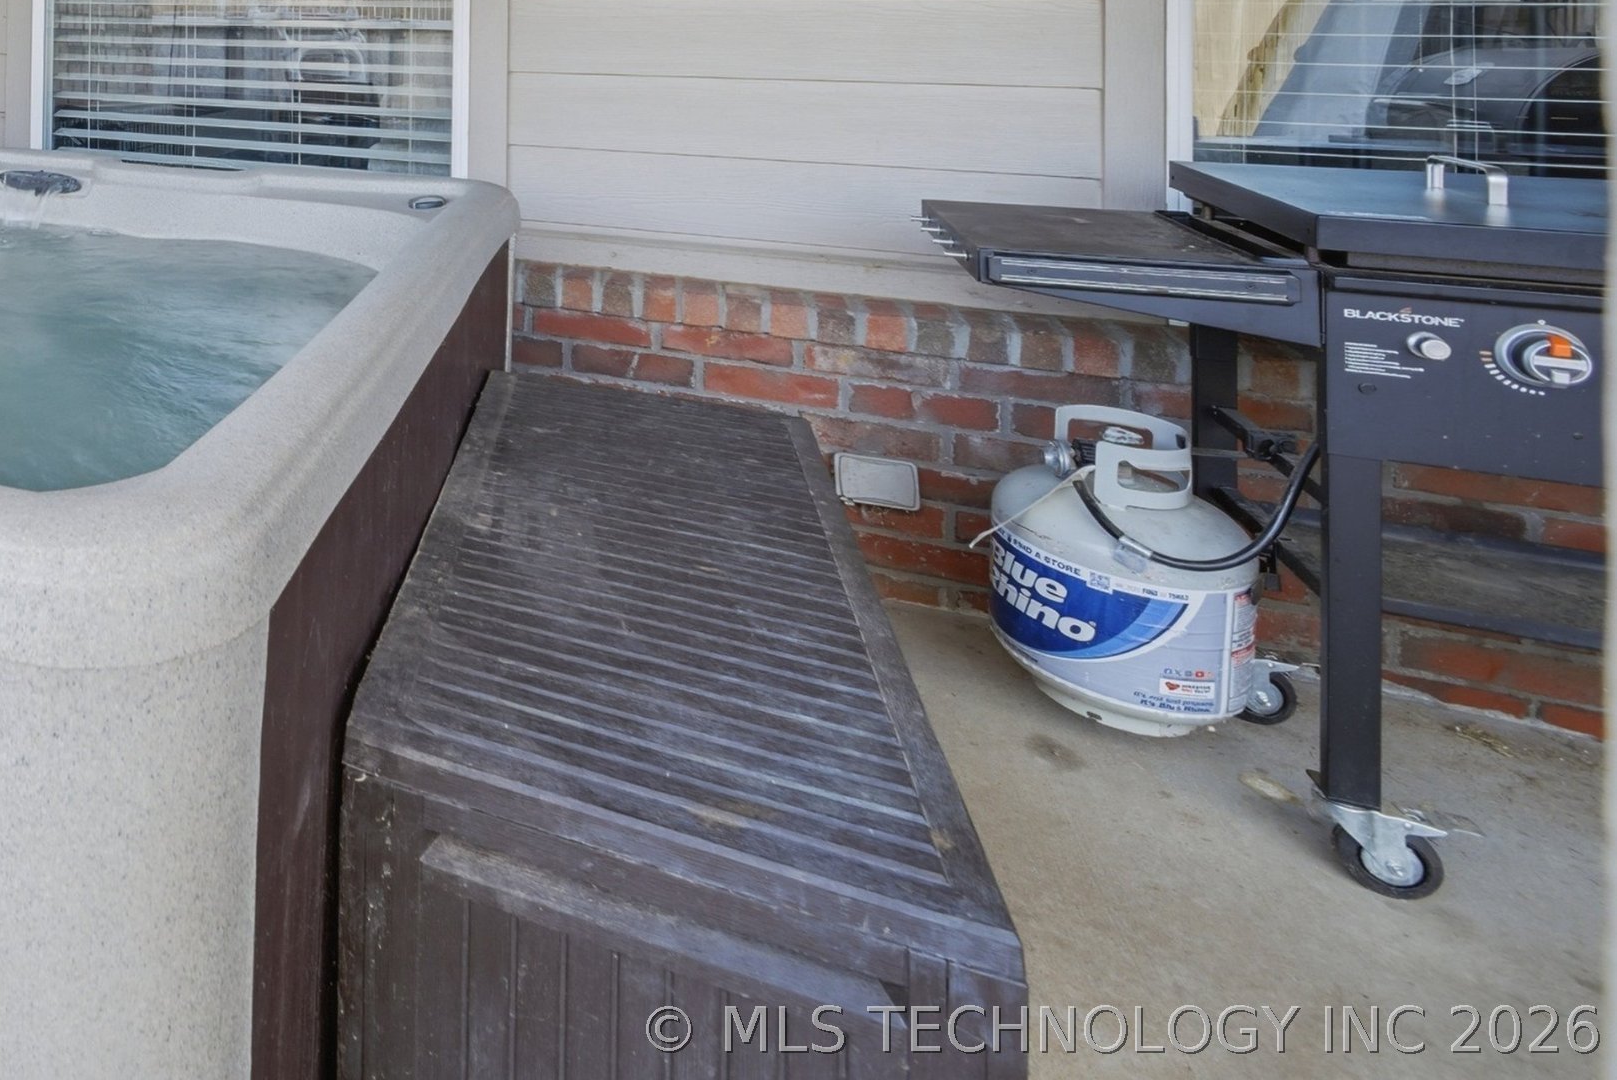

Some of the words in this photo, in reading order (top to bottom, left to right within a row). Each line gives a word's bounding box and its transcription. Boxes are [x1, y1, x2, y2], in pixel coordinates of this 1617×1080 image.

[1343, 308, 1461, 328] BLACKSTONE
[991, 536, 1067, 604] Blue
[1043, 556, 1082, 577] STORE
